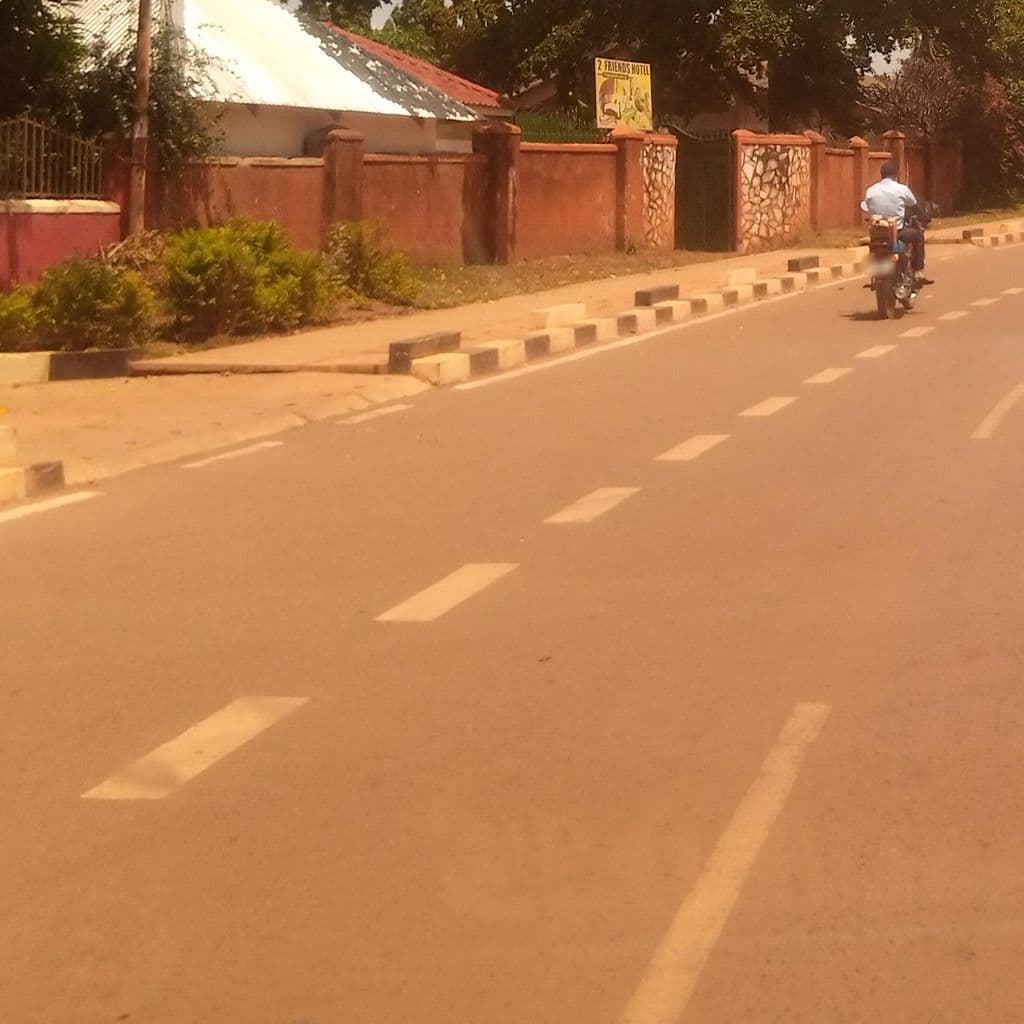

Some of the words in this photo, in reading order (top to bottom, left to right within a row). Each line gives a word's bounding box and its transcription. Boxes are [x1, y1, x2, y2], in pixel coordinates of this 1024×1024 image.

[597, 59, 602, 70] 2
[604, 61, 630, 73] FRIENDS
[631, 64, 649, 75] HOTEL
